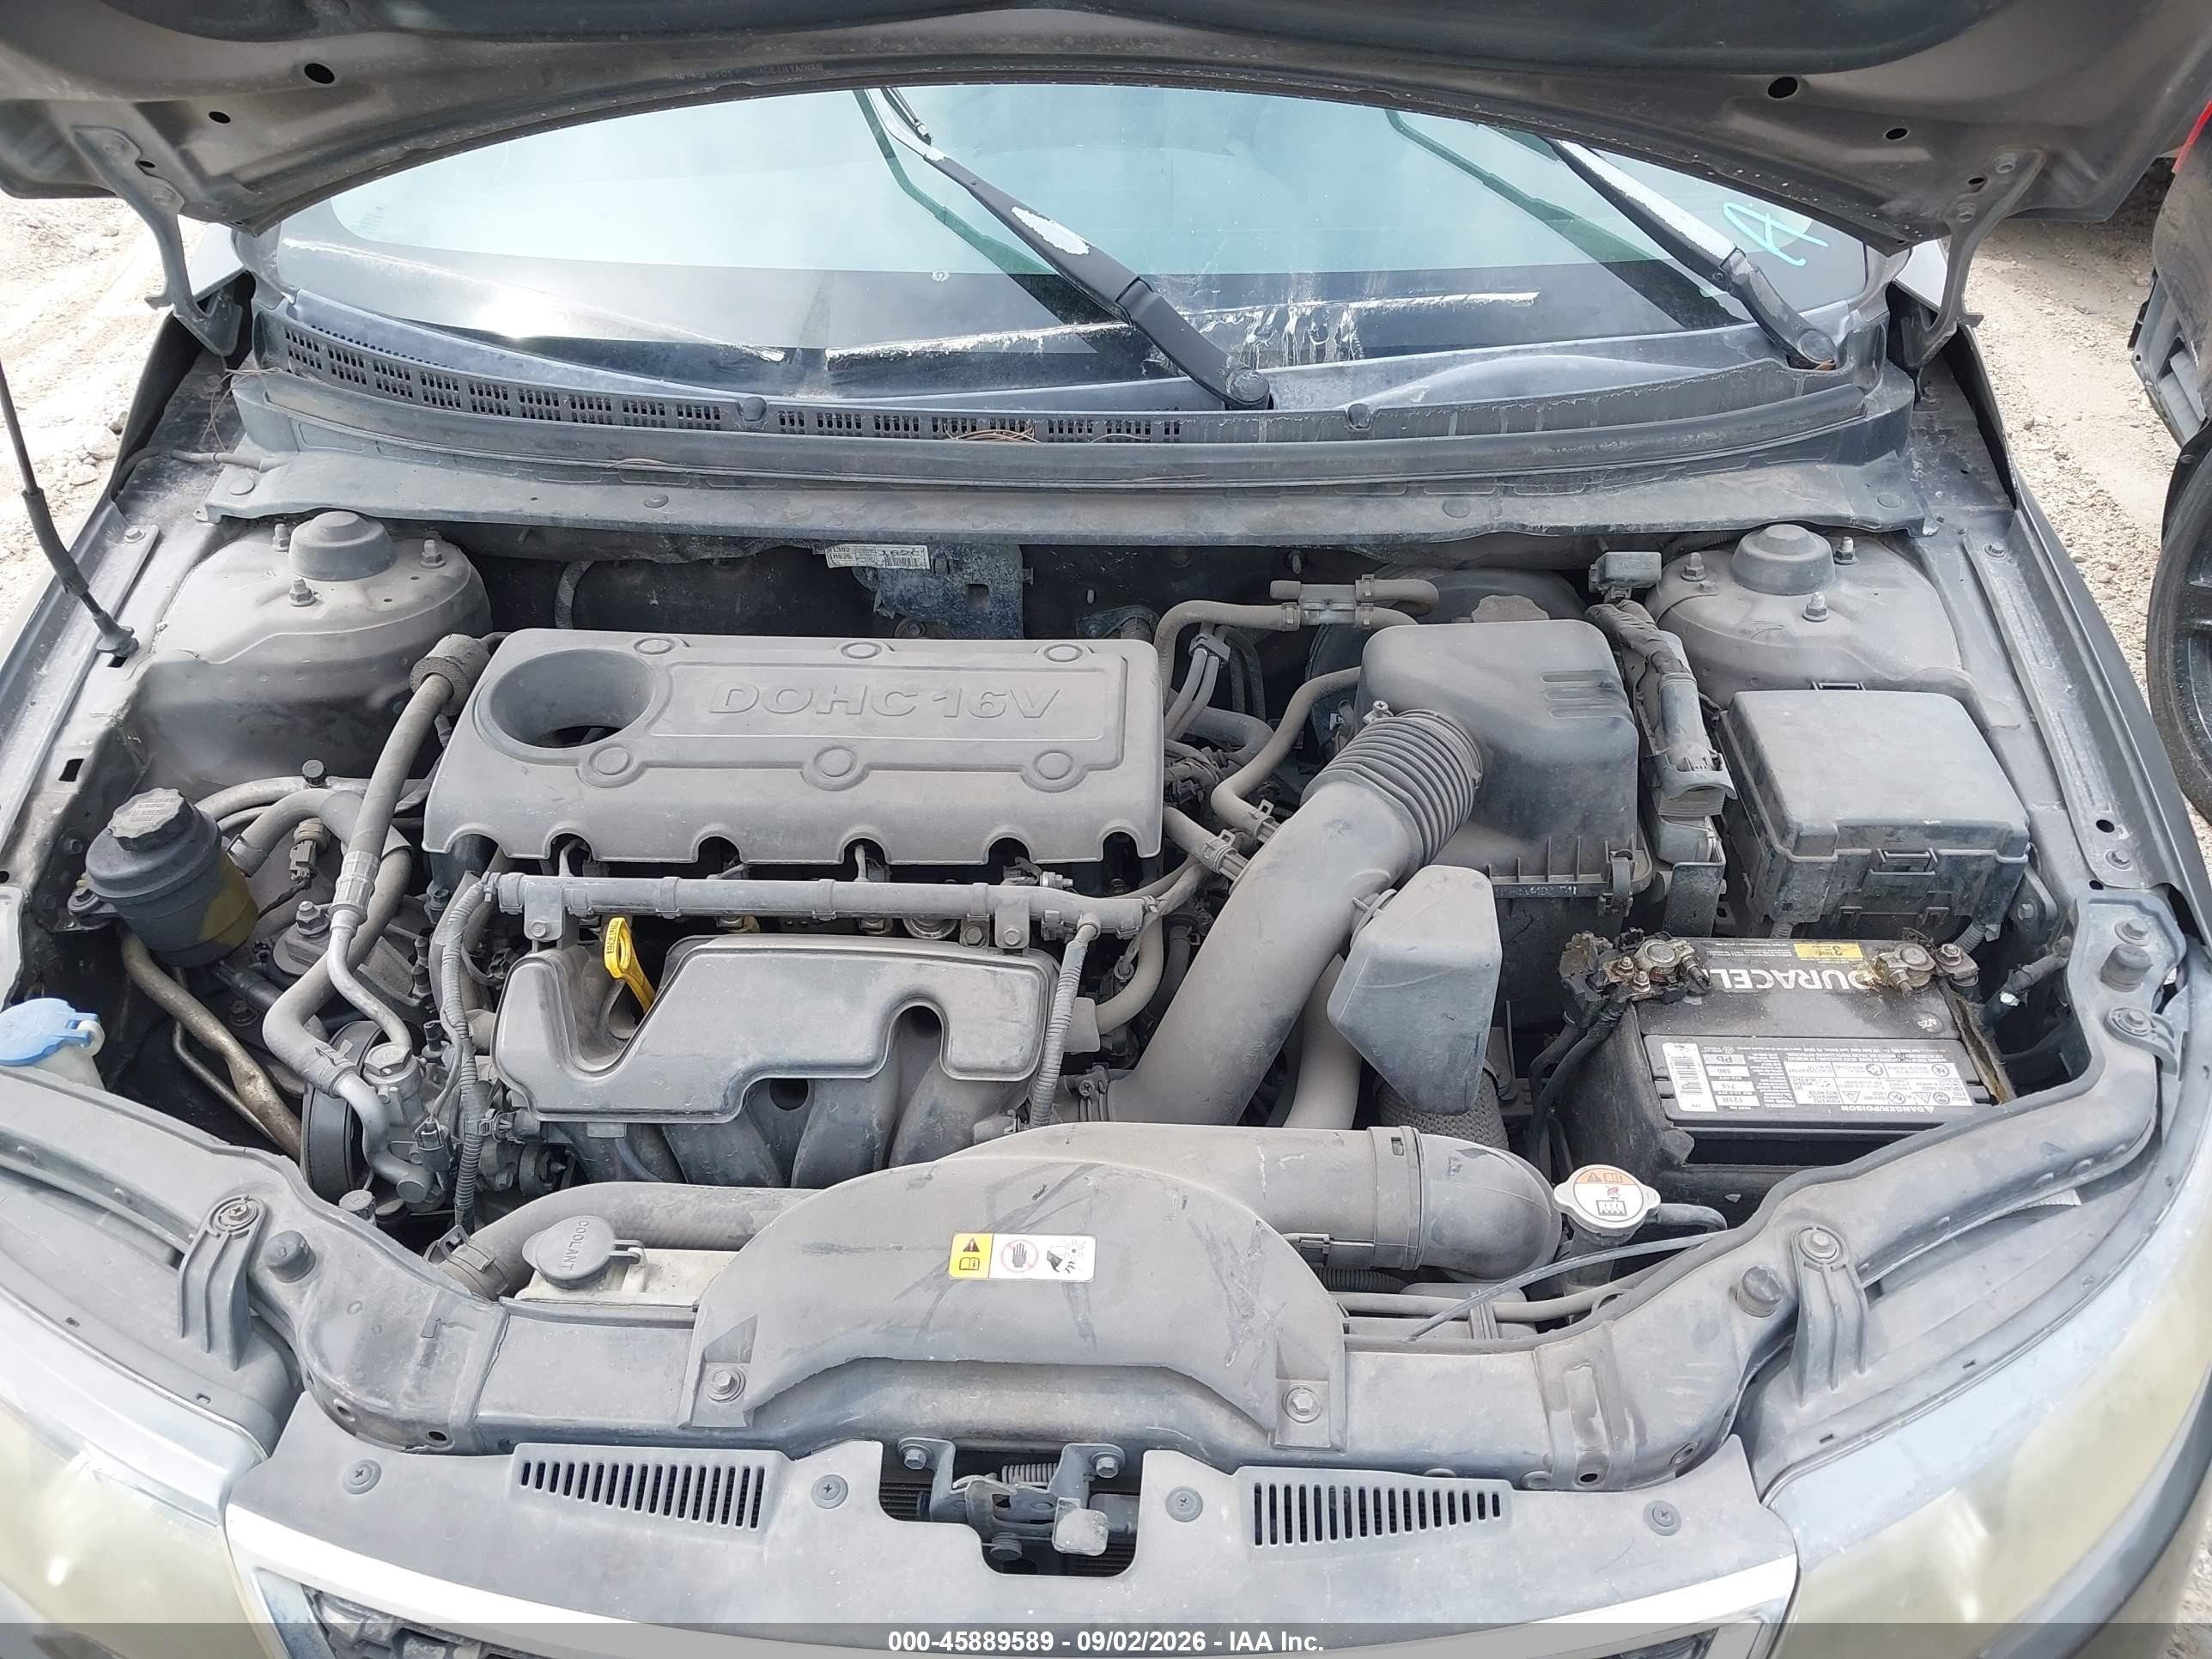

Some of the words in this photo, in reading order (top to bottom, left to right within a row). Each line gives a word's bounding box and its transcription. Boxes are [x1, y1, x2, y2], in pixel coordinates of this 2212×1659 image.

[1723, 201, 1829, 266] A
[708, 683, 918, 717] DOHC
[932, 685, 1060, 720] 16V
[1832, 945, 1843, 957] 3
[1704, 969, 1873, 991] DURACEL
[561, 1220, 590, 1271] COOLANT
